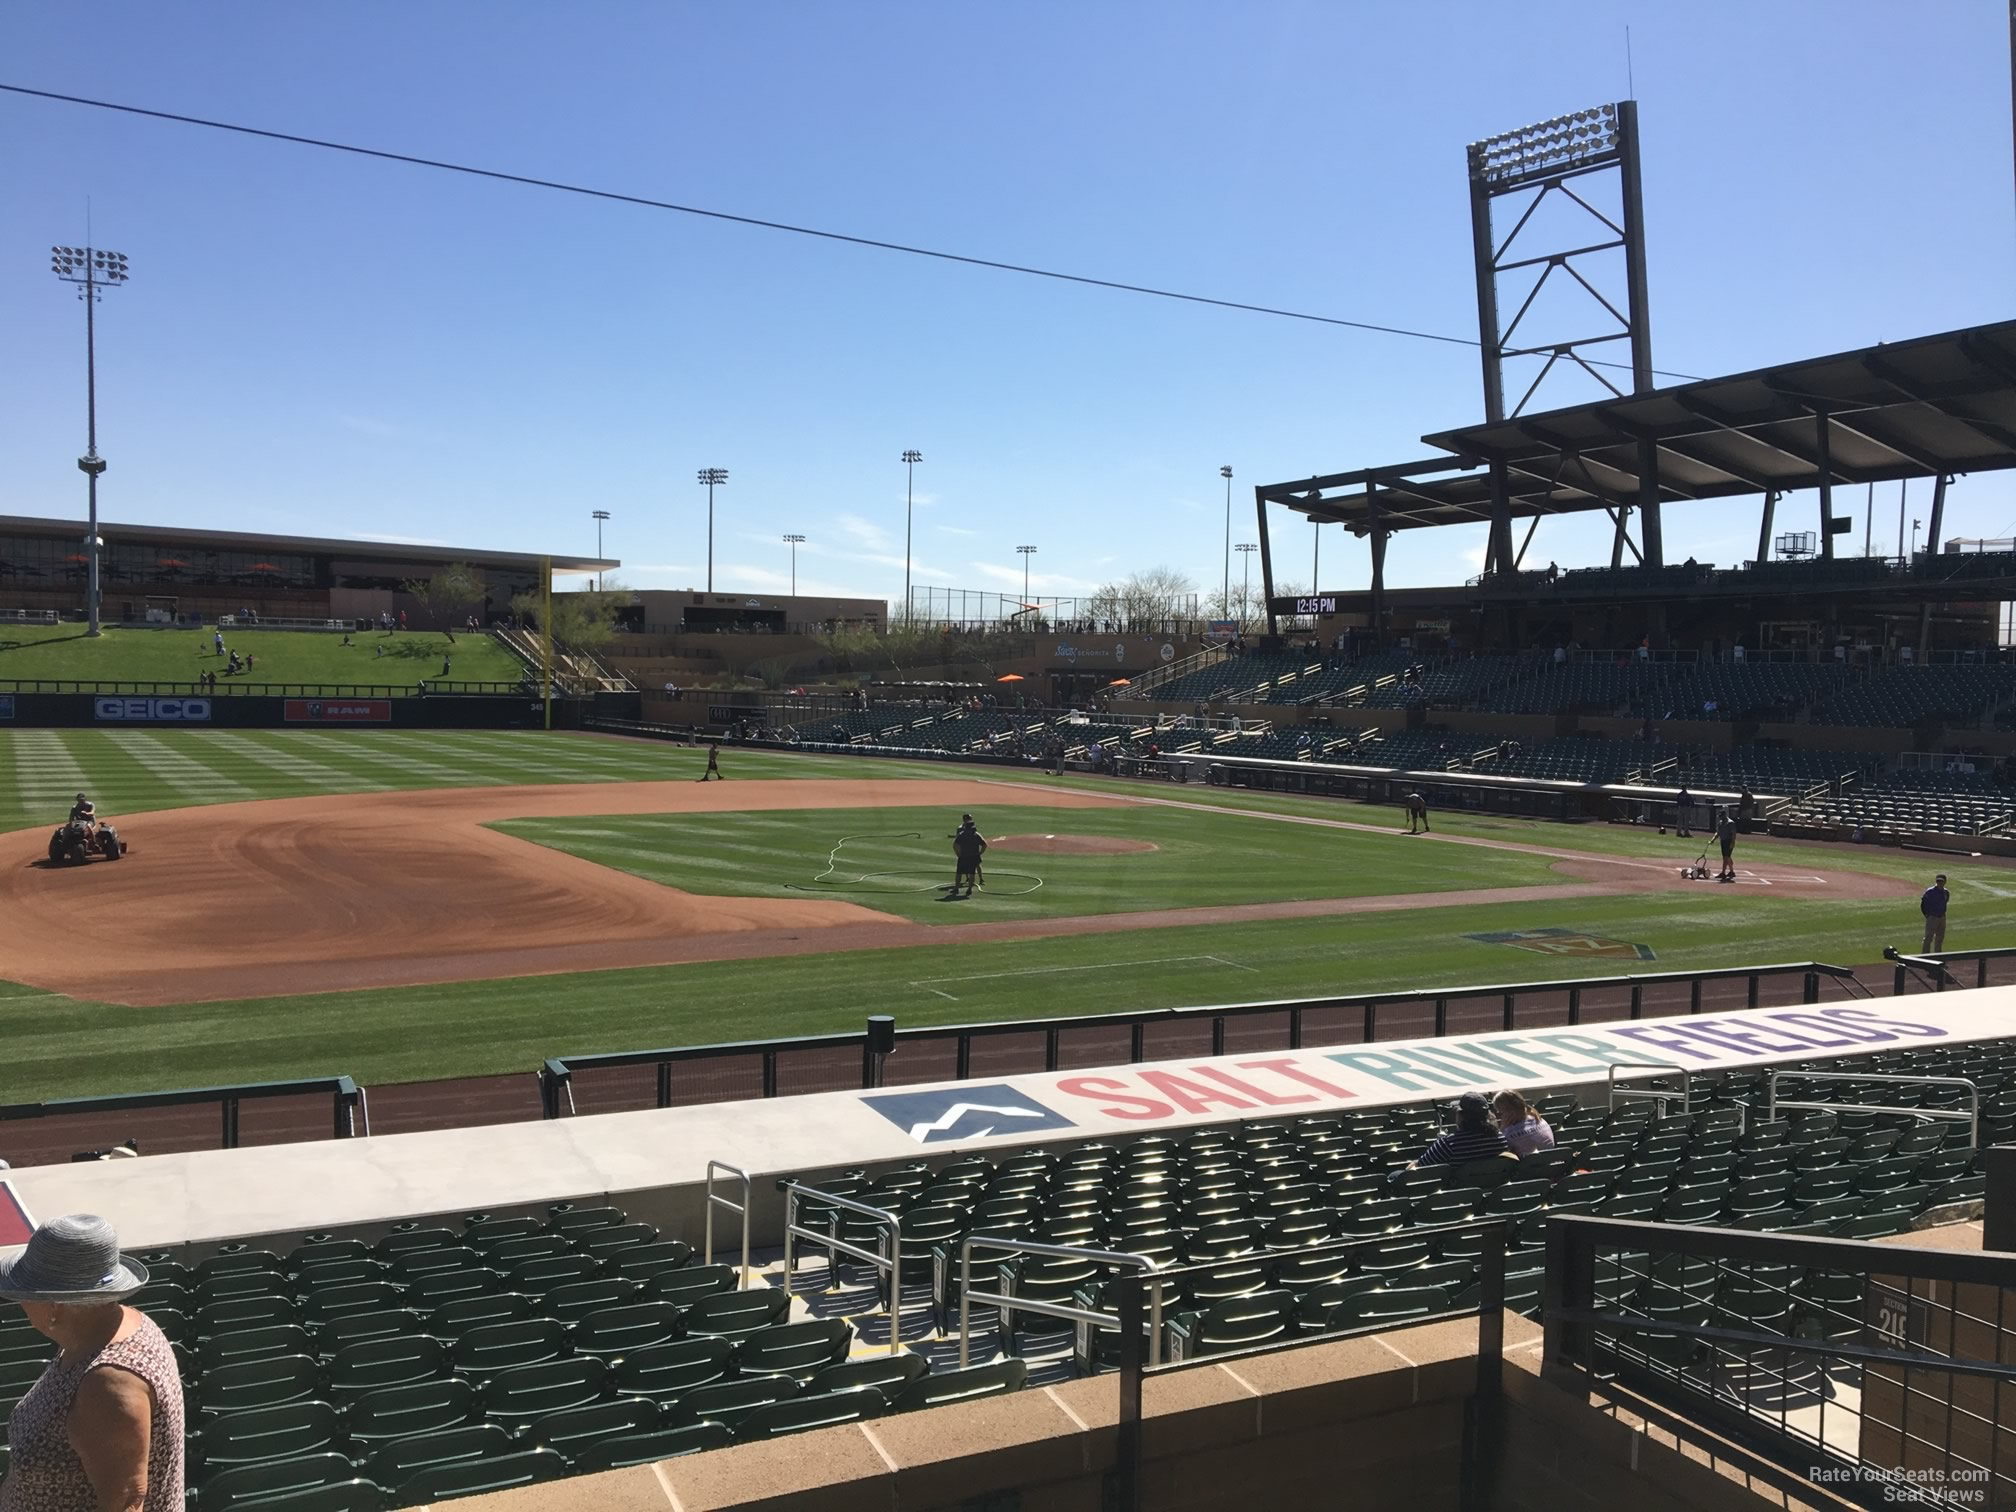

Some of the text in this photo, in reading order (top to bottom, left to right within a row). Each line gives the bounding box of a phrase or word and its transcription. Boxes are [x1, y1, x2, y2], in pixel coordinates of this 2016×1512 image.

[1297, 598, 1336, 613] 12:15 PM
[95, 700, 210, 719] GEICO
[327, 707, 370, 715] RAM
[531, 703, 544, 711] 345
[1056, 1008, 1950, 1121] SALT RIVER FIELDS
[1883, 1297, 1908, 1313] SECTION
